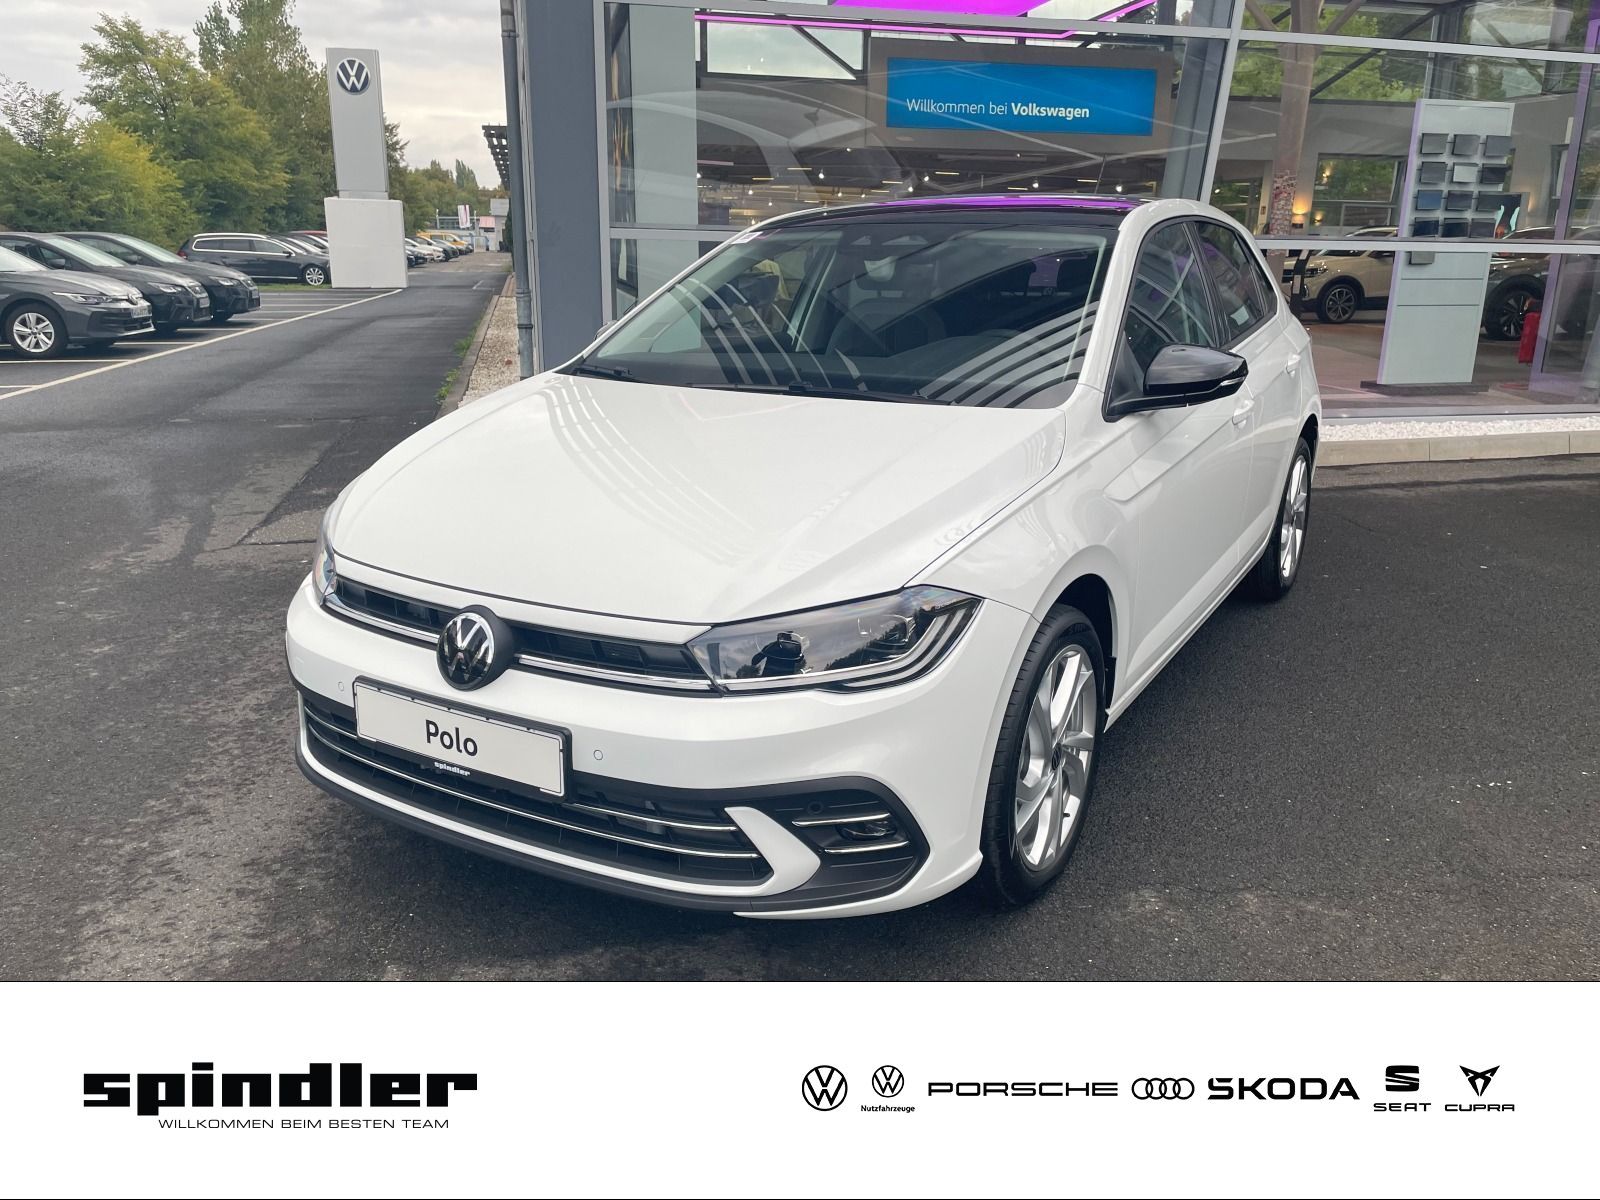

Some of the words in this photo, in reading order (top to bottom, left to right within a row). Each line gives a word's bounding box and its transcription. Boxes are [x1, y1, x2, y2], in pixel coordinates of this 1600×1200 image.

[906, 98, 985, 115] Willkommen
[990, 101, 1008, 115] bei
[1010, 102, 1090, 121] Volkswagen
[425, 719, 478, 756] Polo
[434, 761, 471, 777] spindler
